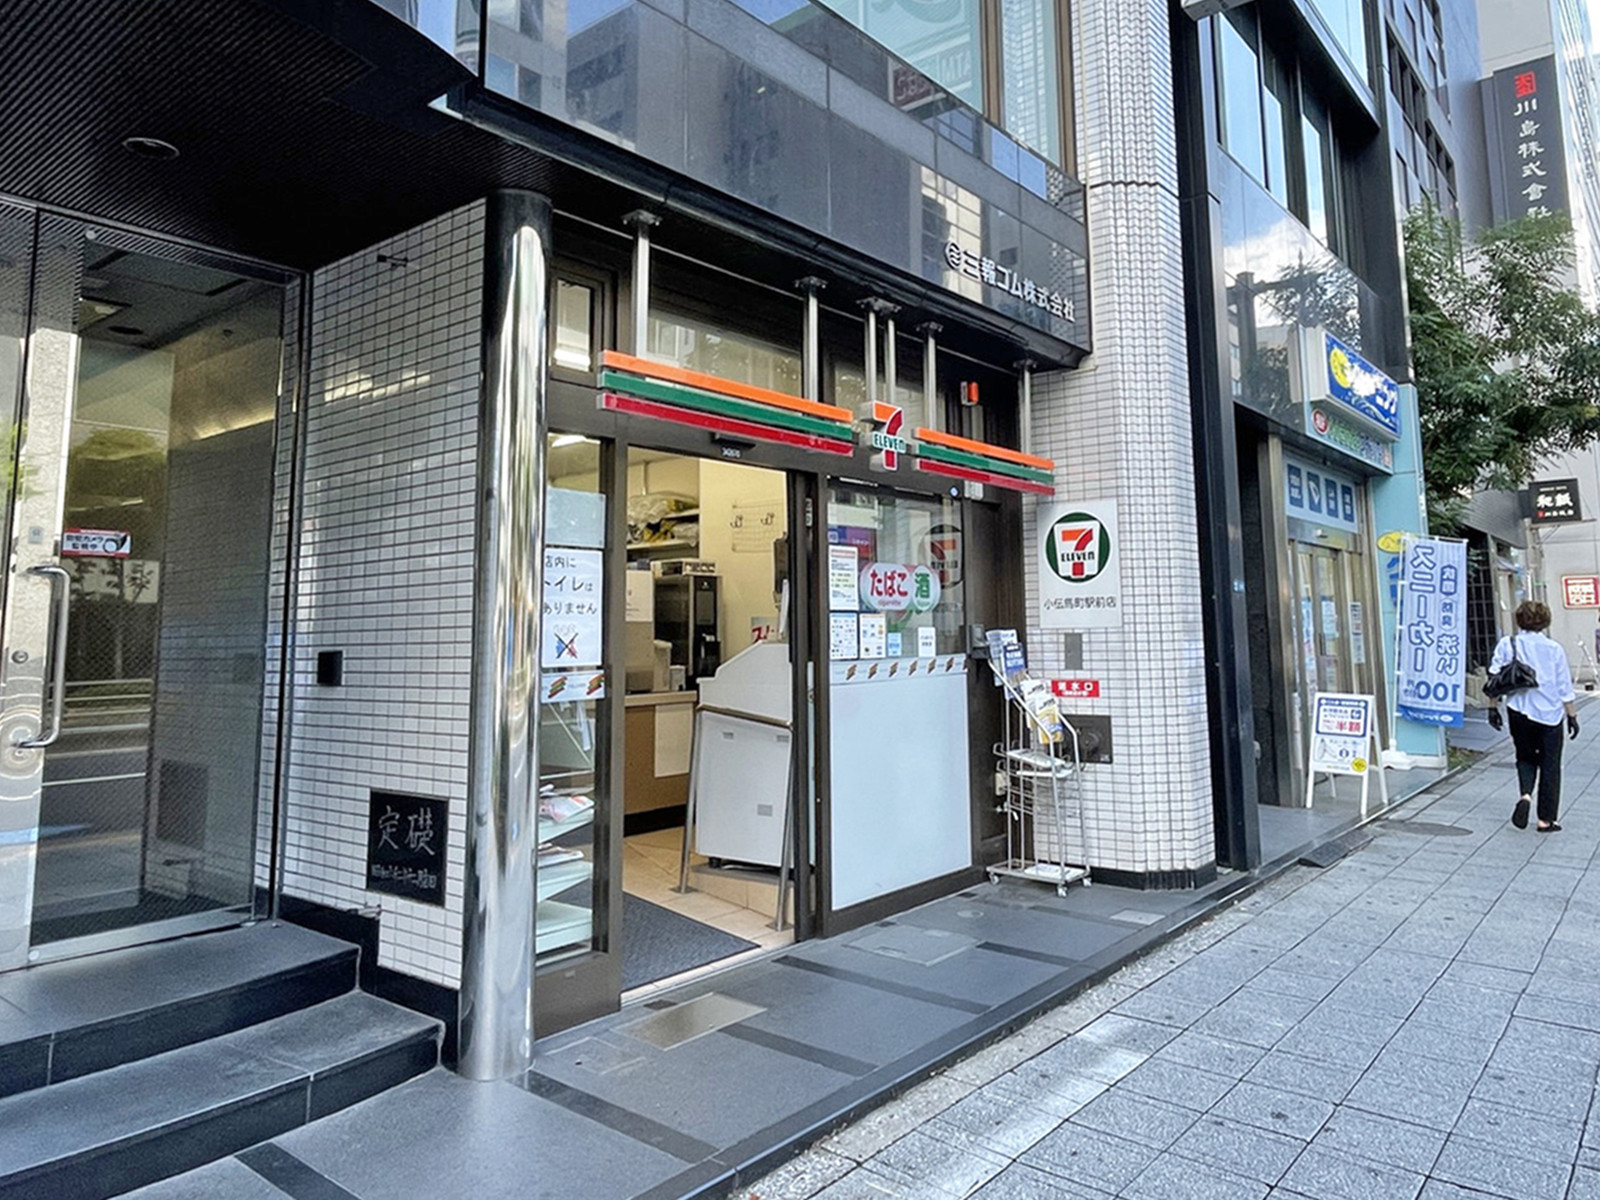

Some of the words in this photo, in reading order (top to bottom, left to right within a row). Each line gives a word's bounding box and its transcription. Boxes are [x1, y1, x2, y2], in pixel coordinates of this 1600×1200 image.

[870, 569, 908, 598] たばこ
[914, 572, 930, 598] 酒
[378, 804, 435, 856] 定礎
